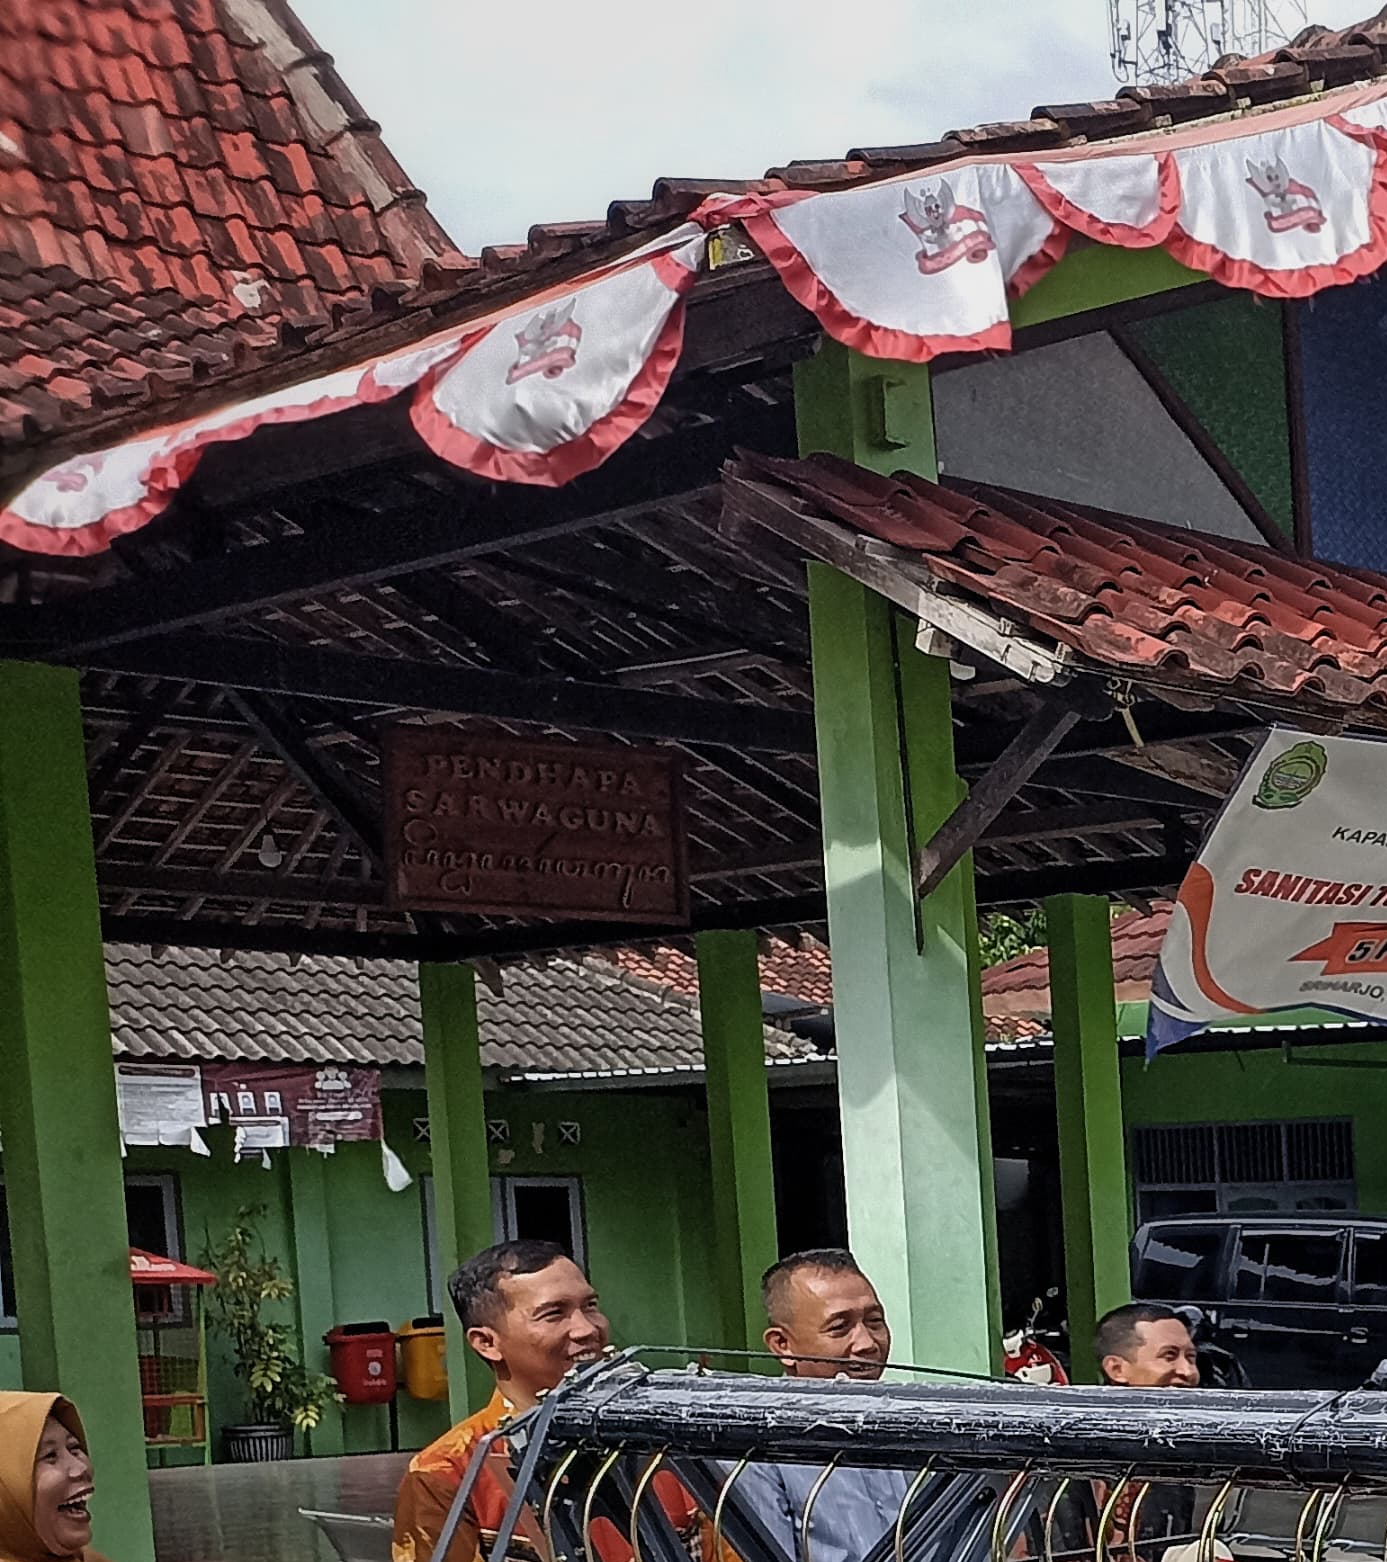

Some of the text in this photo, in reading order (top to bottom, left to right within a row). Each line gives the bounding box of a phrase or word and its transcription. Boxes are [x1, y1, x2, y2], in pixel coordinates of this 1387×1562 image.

[425, 754, 642, 796] PENDHAPA
[404, 788, 664, 837] SARWAGUNA
[1235, 868, 1374, 907] SANITASI
[1349, 940, 1377, 963] 5
